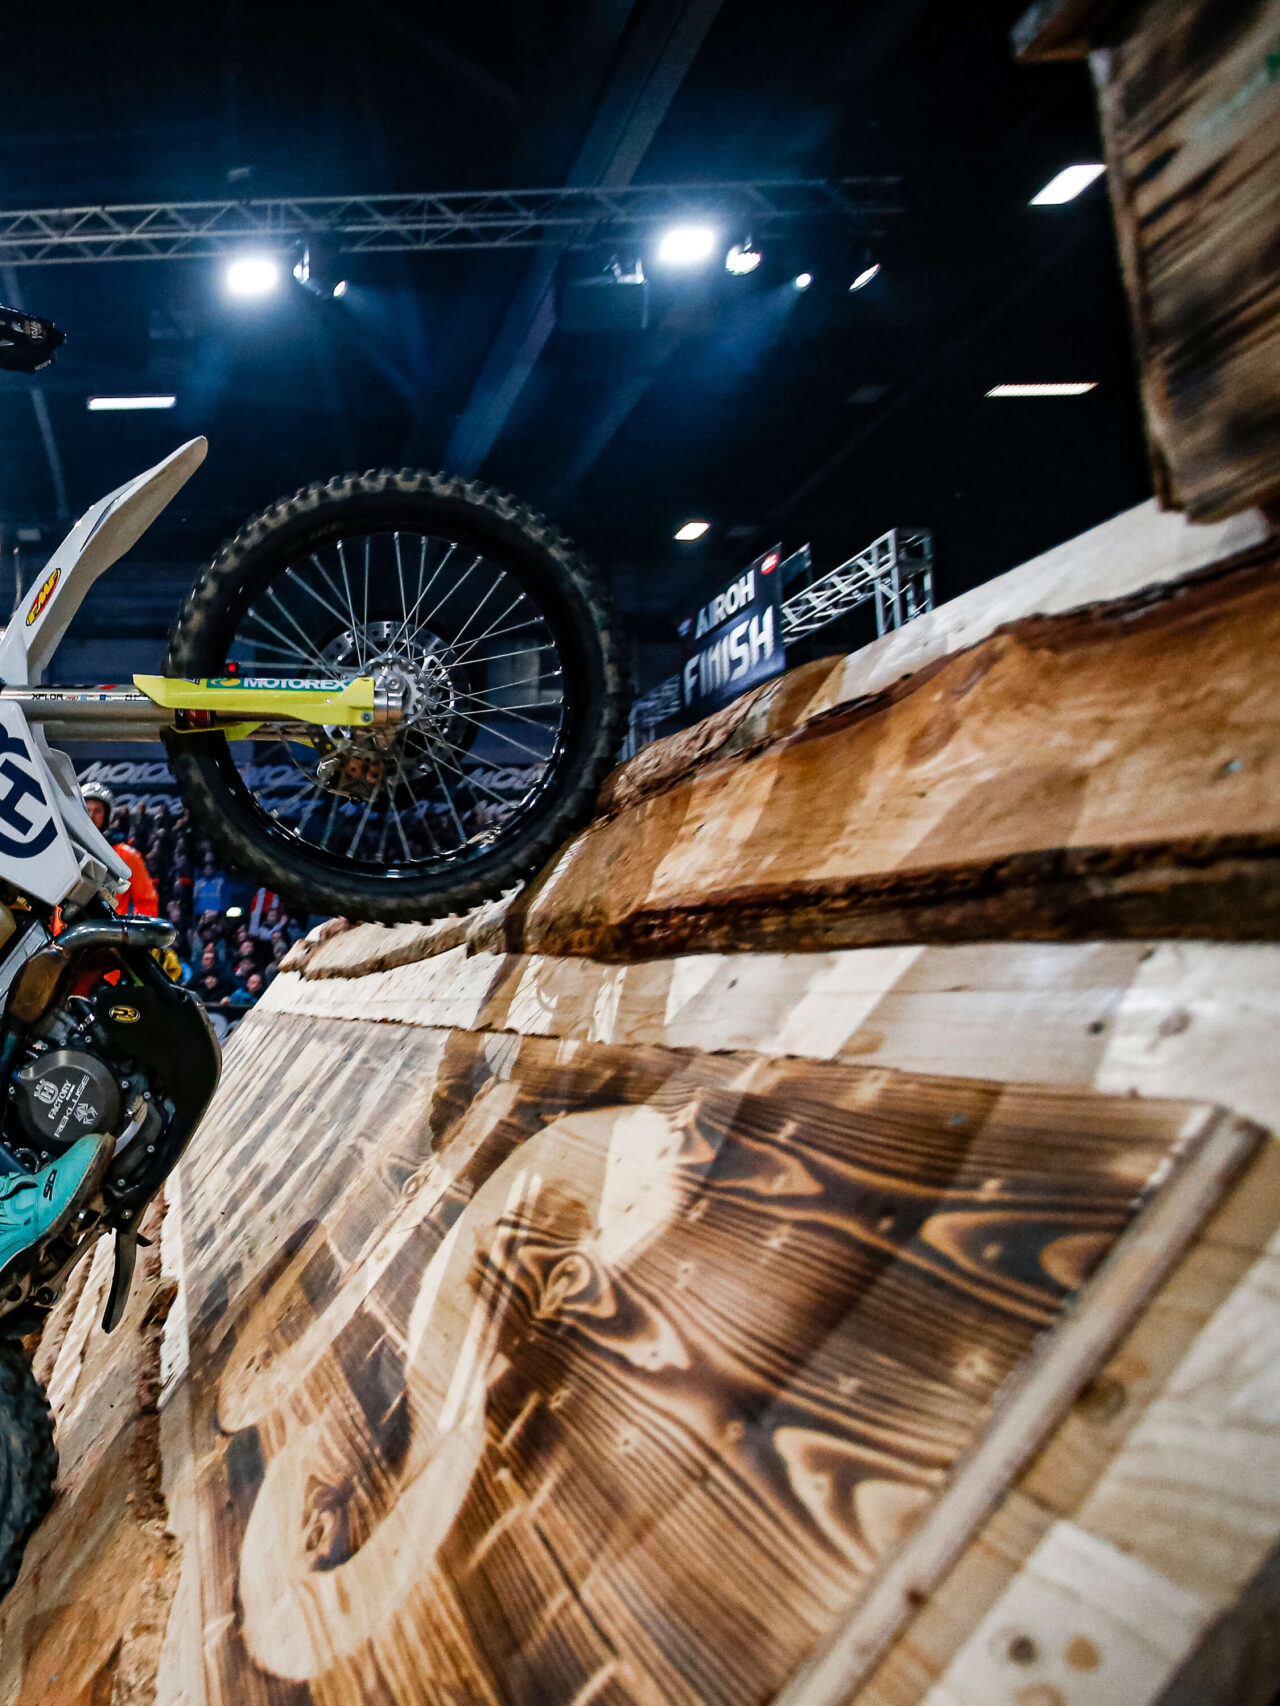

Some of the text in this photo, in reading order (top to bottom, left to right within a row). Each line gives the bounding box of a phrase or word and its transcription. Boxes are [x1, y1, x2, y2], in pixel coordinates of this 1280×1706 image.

[683, 604, 775, 707] FINISH
[32, 693, 63, 701] XPLOR
[244, 677, 343, 692] MOTOREX
[53, 1074, 90, 1139] REKLUSE
